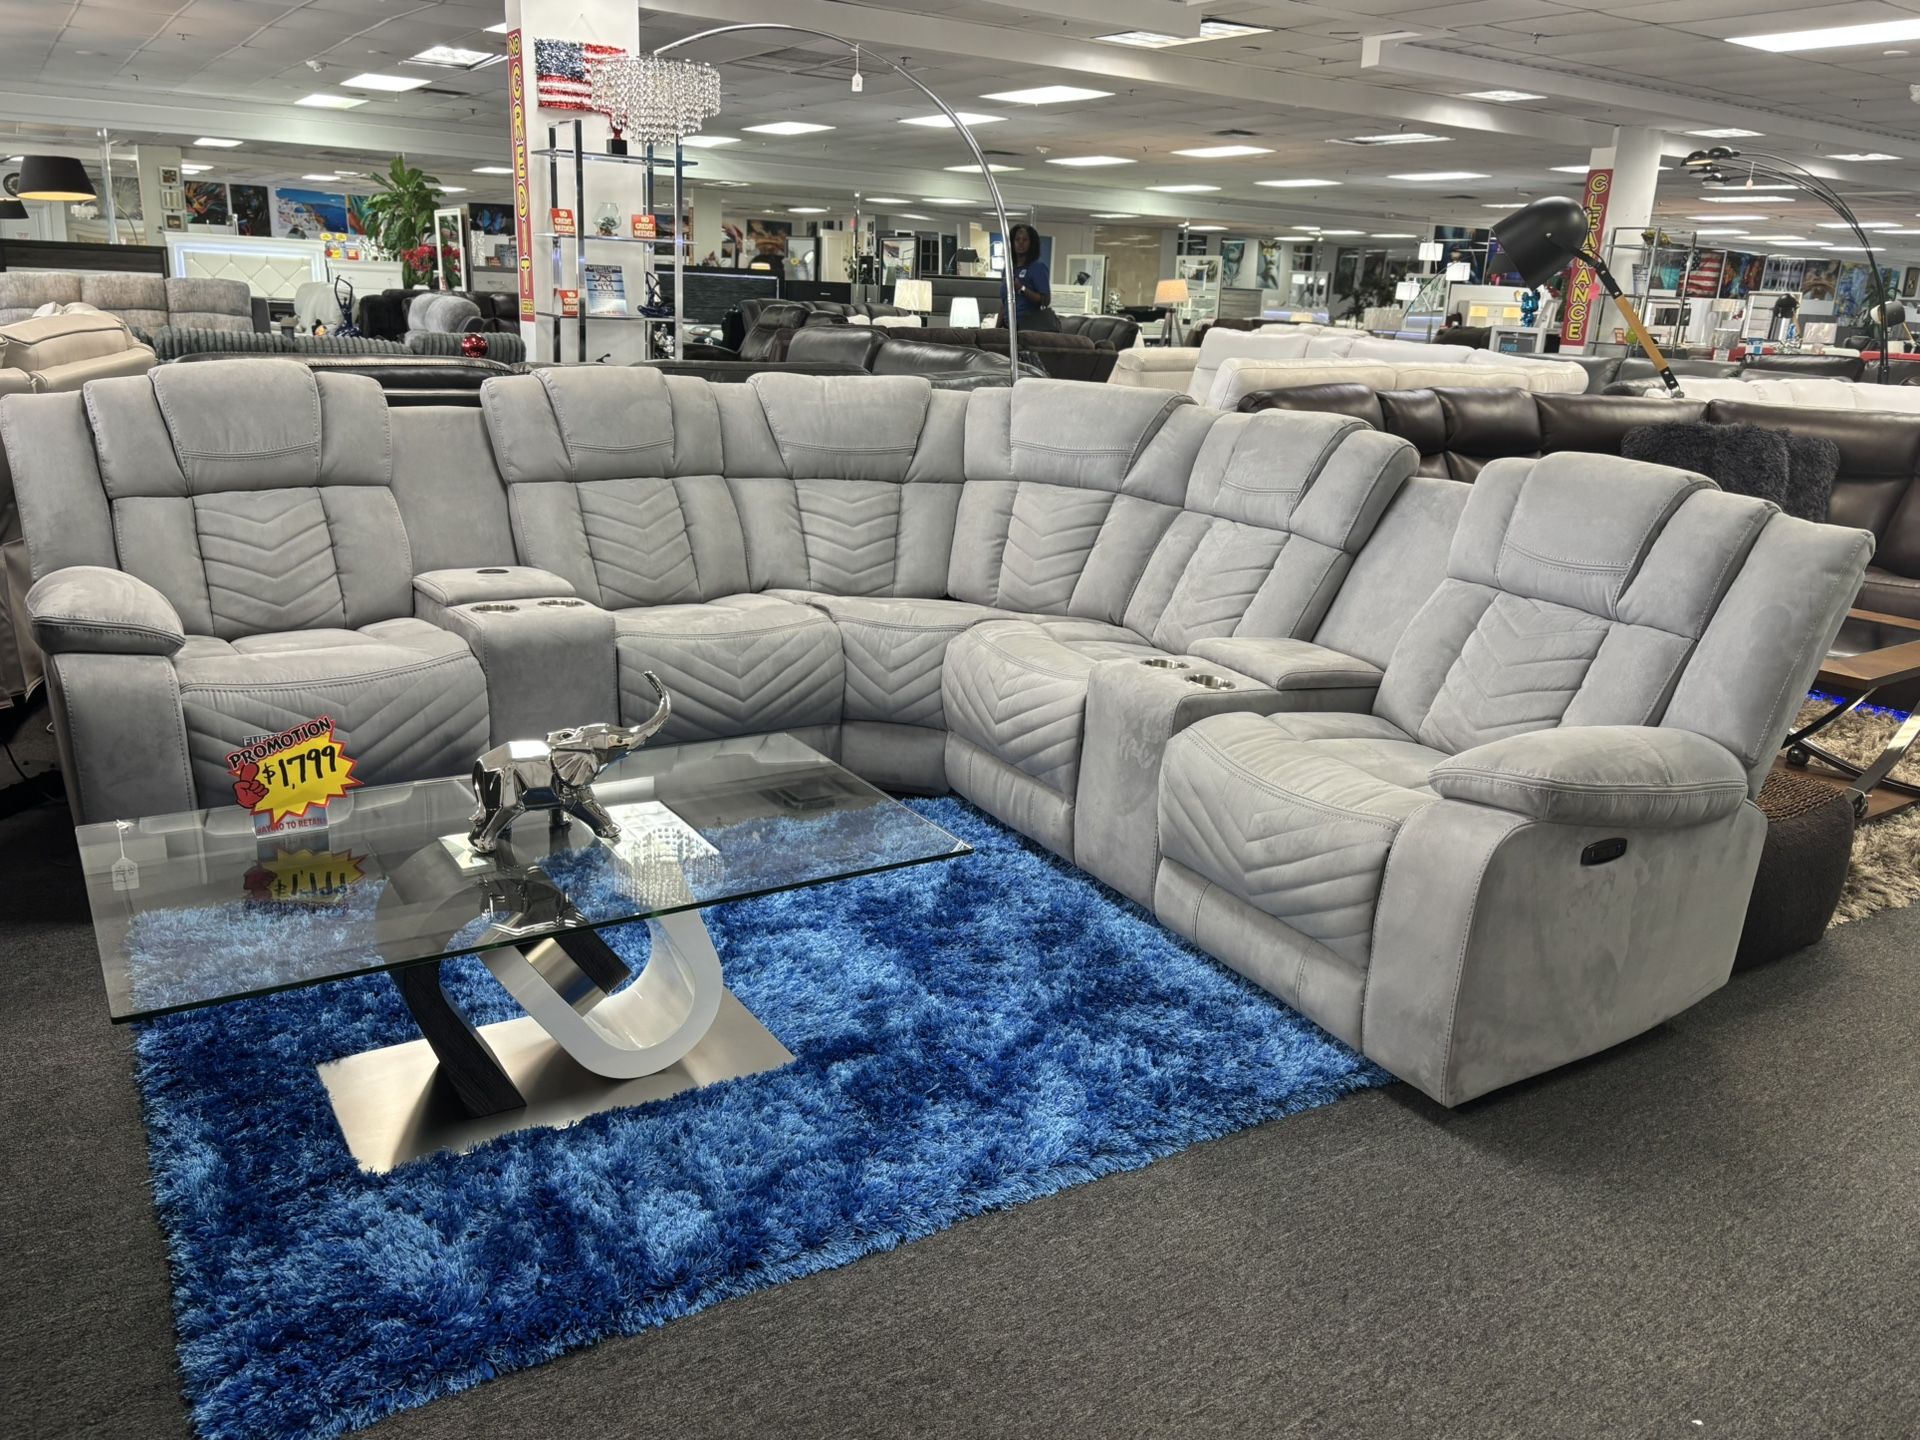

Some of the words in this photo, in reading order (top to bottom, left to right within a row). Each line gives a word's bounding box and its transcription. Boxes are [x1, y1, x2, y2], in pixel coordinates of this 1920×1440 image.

[508, 33, 521, 59] NO
[512, 61, 531, 295] CREDIT
[227, 716, 332, 769] PROMOTION
[262, 745, 337, 790] $1,799
[286, 820, 296, 830] TO
